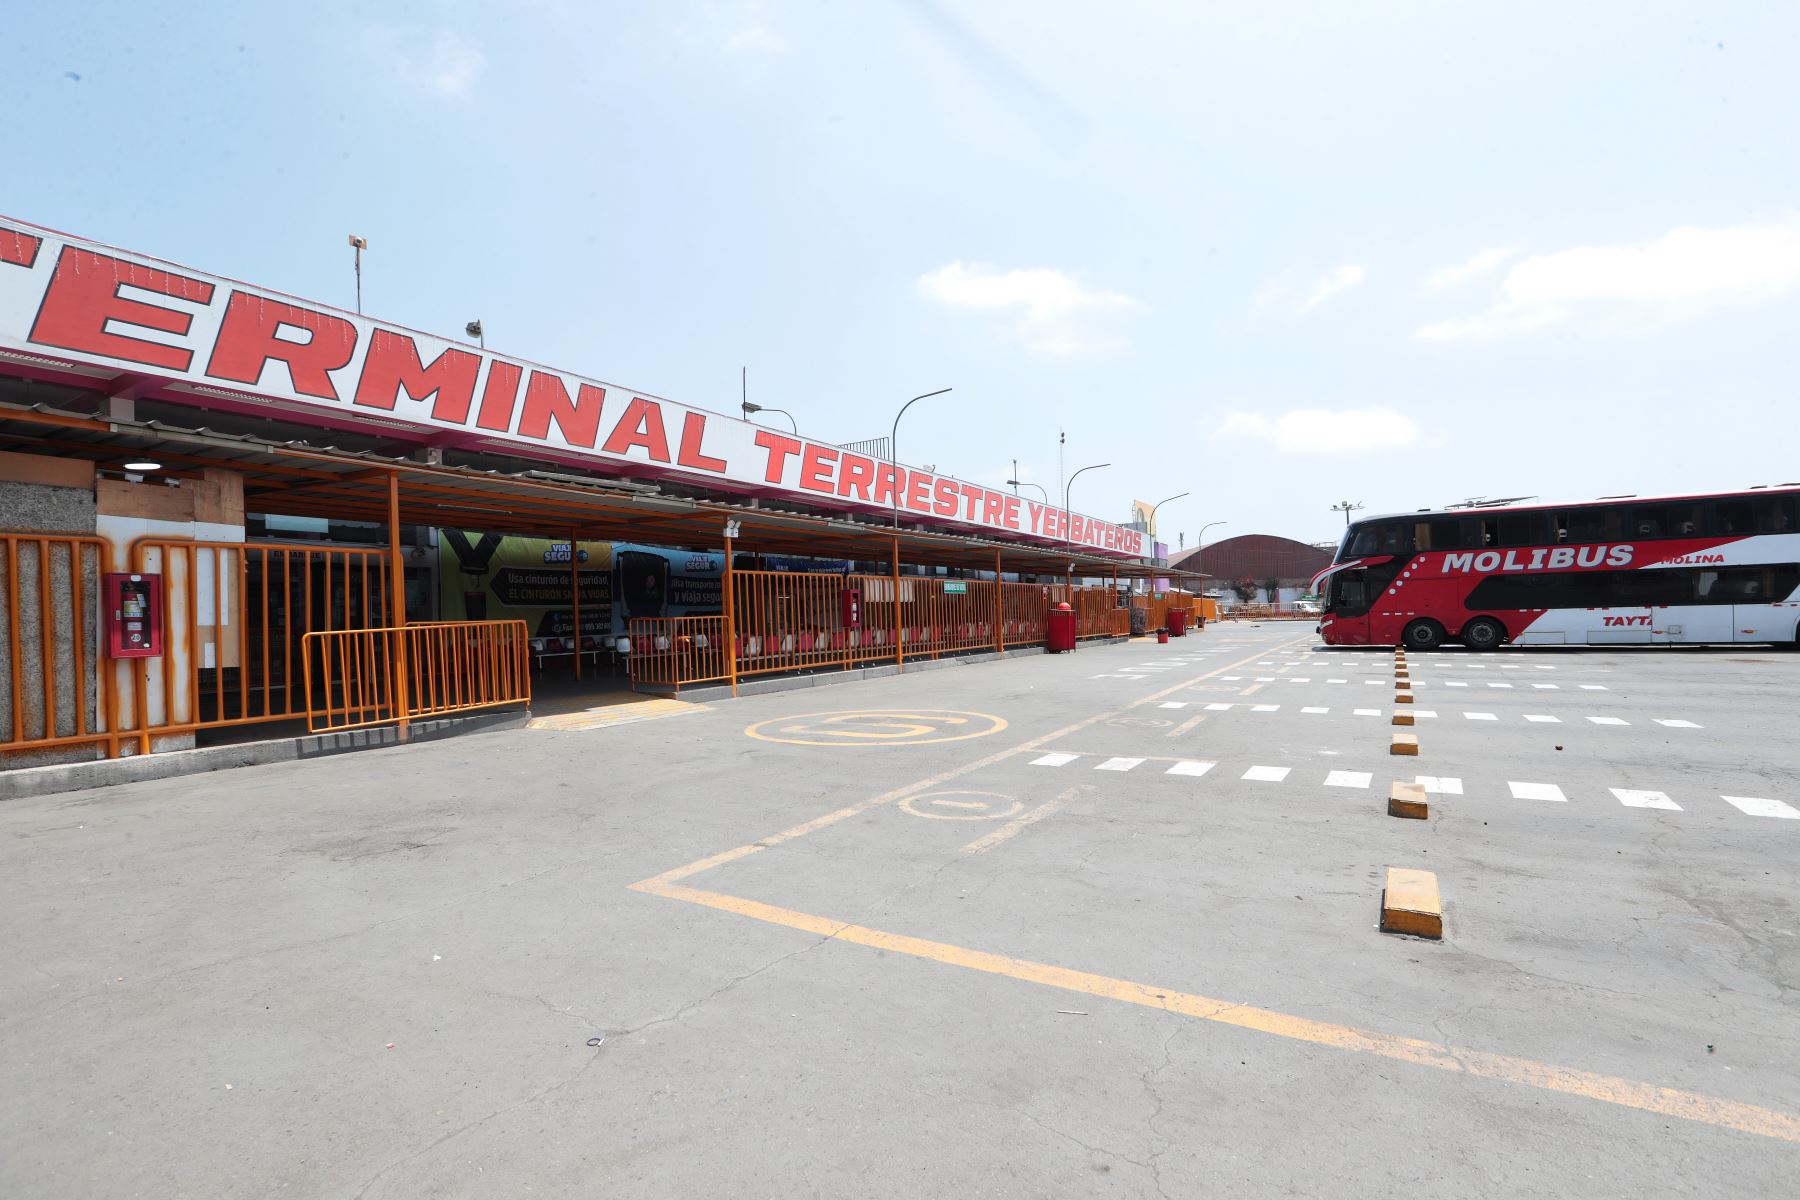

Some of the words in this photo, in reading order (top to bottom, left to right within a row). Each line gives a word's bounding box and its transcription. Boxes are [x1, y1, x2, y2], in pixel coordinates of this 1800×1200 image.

[0, 227, 727, 474] ERMINAL
[755, 429, 1021, 530] TERRESTRE
[1028, 502, 1143, 554] YERBATEROS
[1441, 544, 1636, 573] MOLIBUS
[508, 573, 523, 584] Usa
